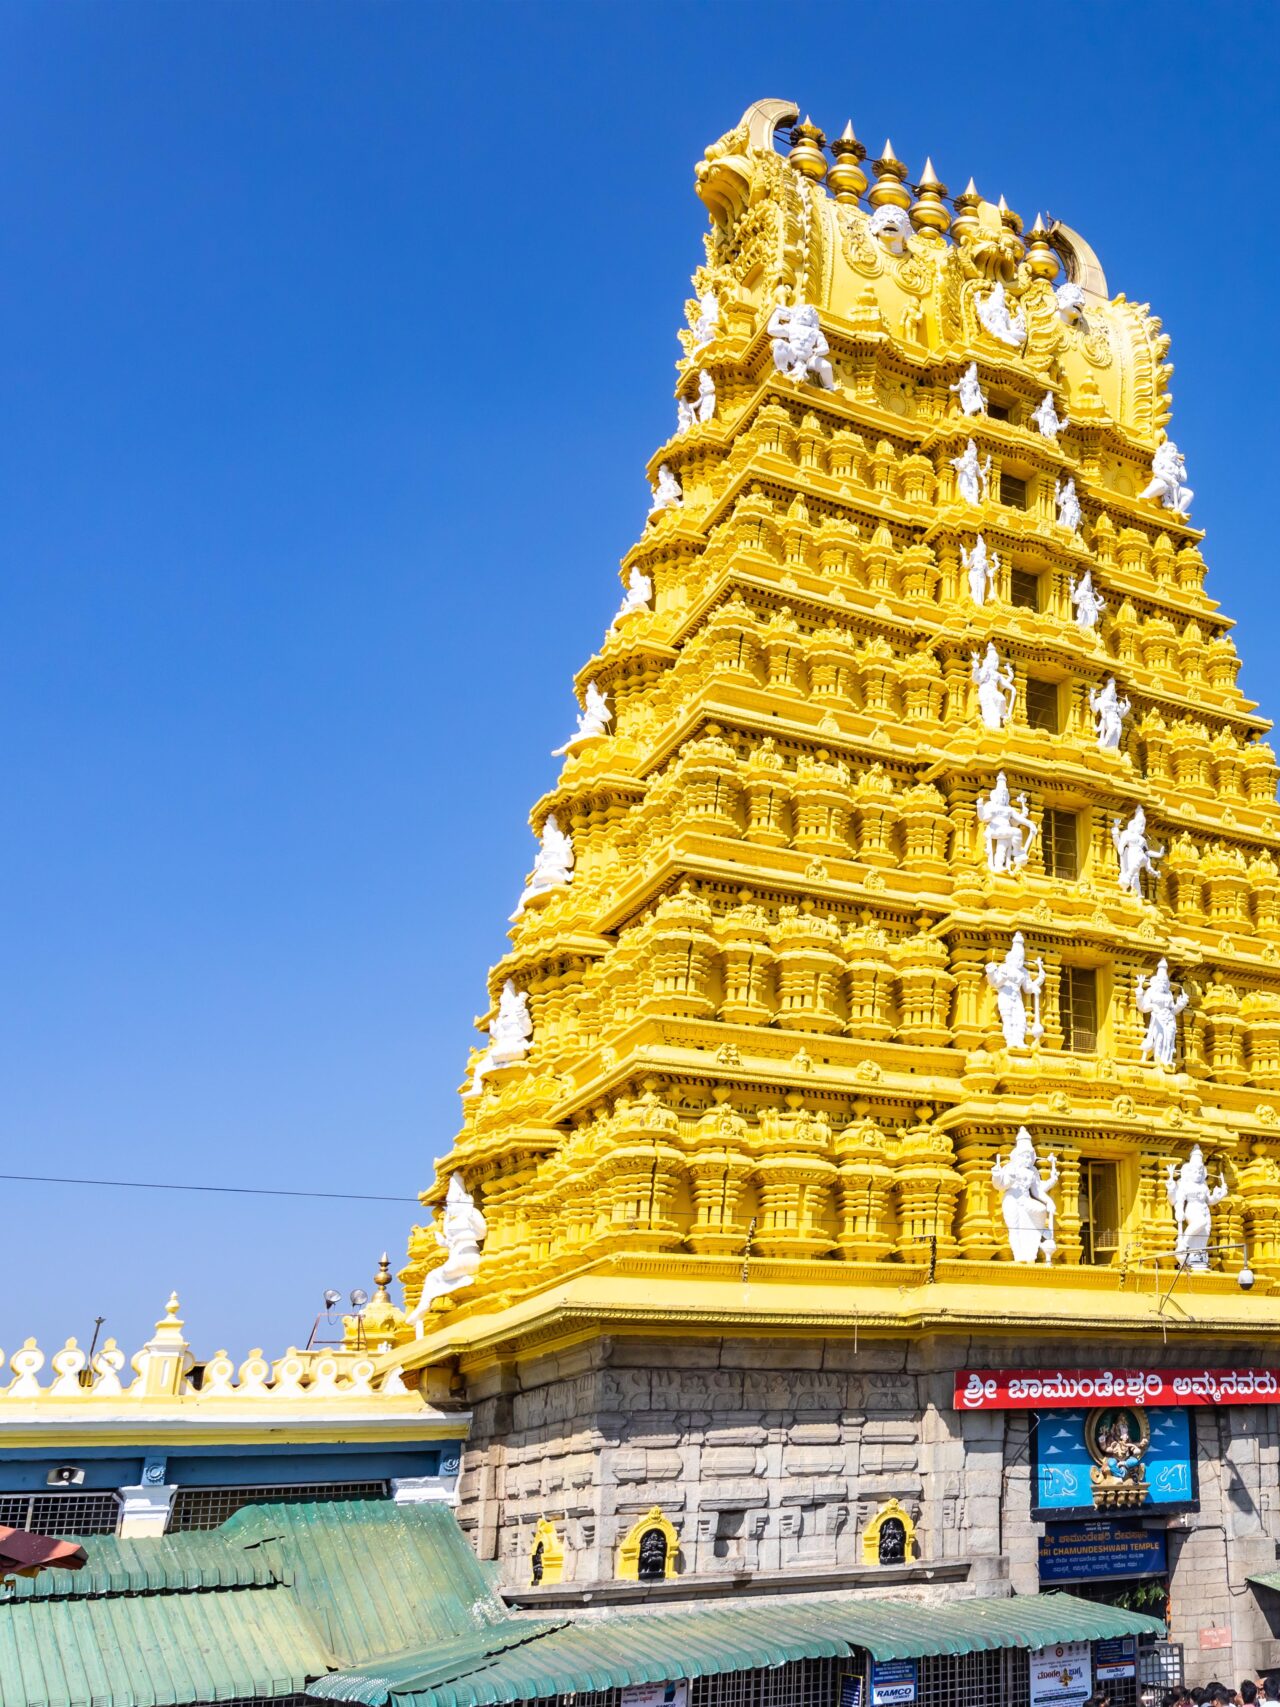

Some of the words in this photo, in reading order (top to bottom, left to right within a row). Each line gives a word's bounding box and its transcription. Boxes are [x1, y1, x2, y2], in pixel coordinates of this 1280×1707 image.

[963, 1373, 997, 1407] ಶ್ರೀ
[1008, 1372, 1163, 1404] ಚಾಮುಂಡೇಶ್ವರಿ
[1172, 1371, 1278, 1402] ಅಮ್ಮನವರು
[1039, 1547, 1051, 1557] HRI
[1053, 1544, 1128, 1555] CHAMUNDESHWARI
[1131, 1542, 1159, 1550] TEMPLE
[877, 1687, 912, 1698] RAMCO
